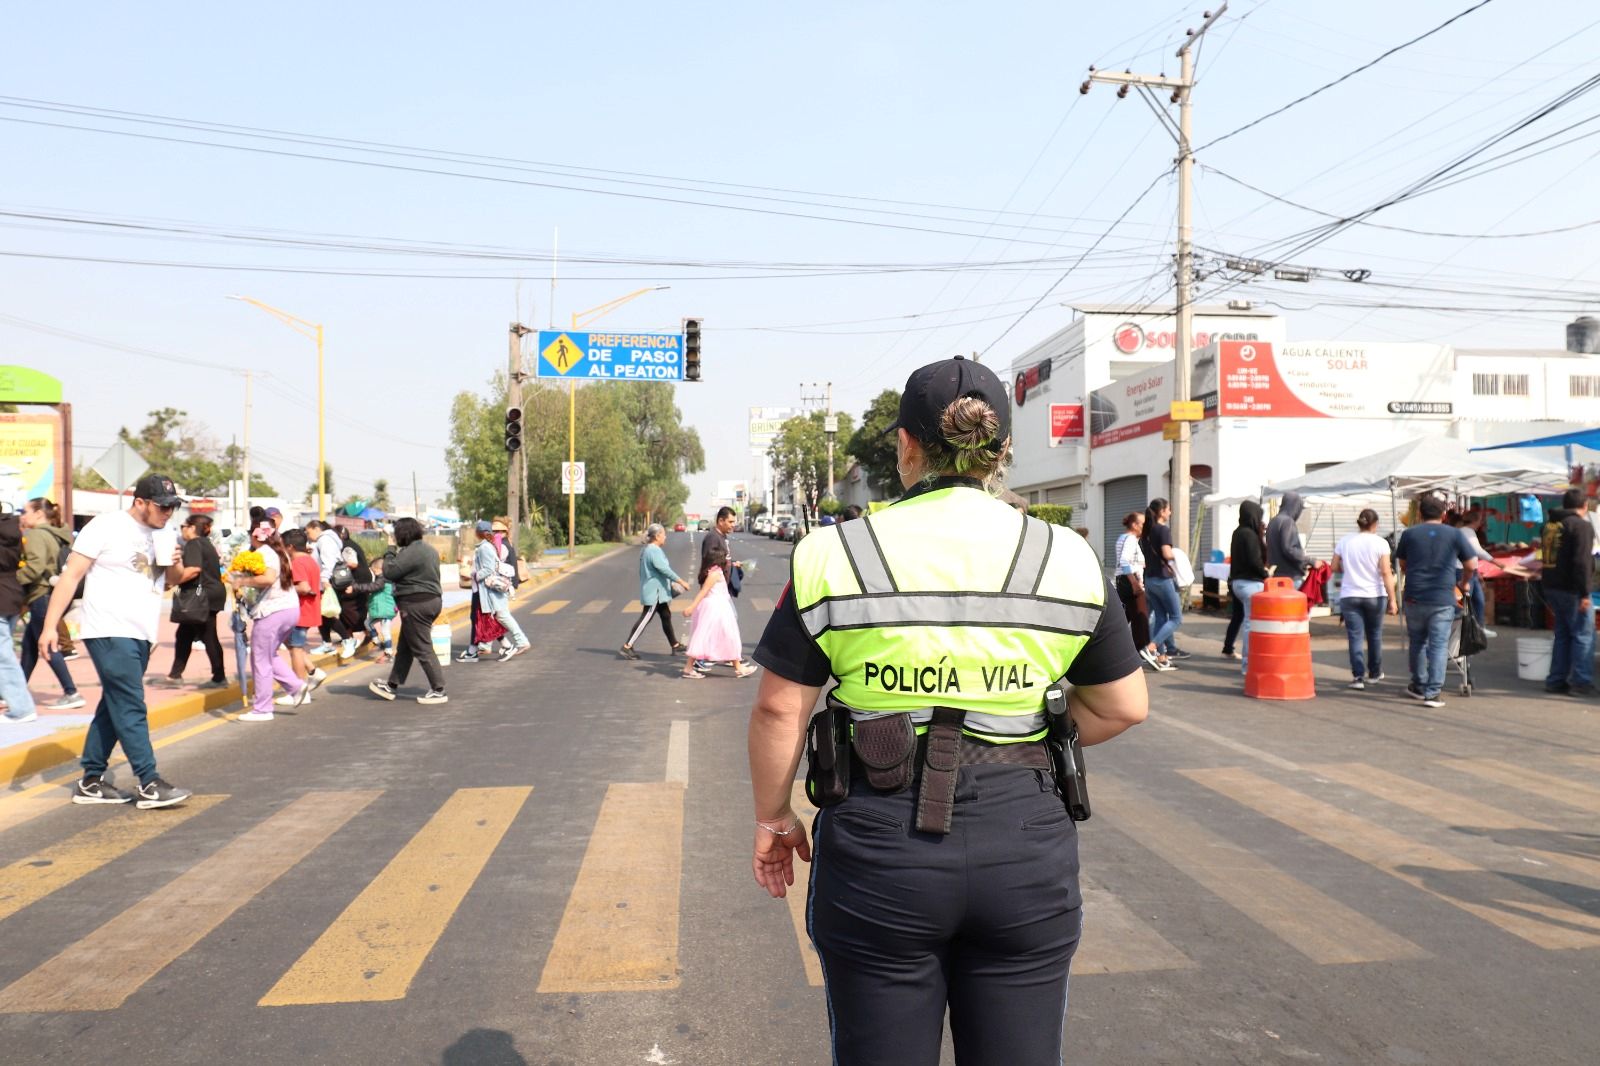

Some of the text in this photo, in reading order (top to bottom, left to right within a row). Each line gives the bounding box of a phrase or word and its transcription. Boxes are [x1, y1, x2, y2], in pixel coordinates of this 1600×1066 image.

[588, 334, 678, 348] PREFERENCIA
[588, 349, 678, 363] DE PASO
[1282, 348, 1366, 358] AGUA CALIENTE
[588, 364, 679, 378] AL PEATON
[1327, 359, 1368, 370] SOLAR
[864, 656, 1035, 694] POLICÍA VIAL
